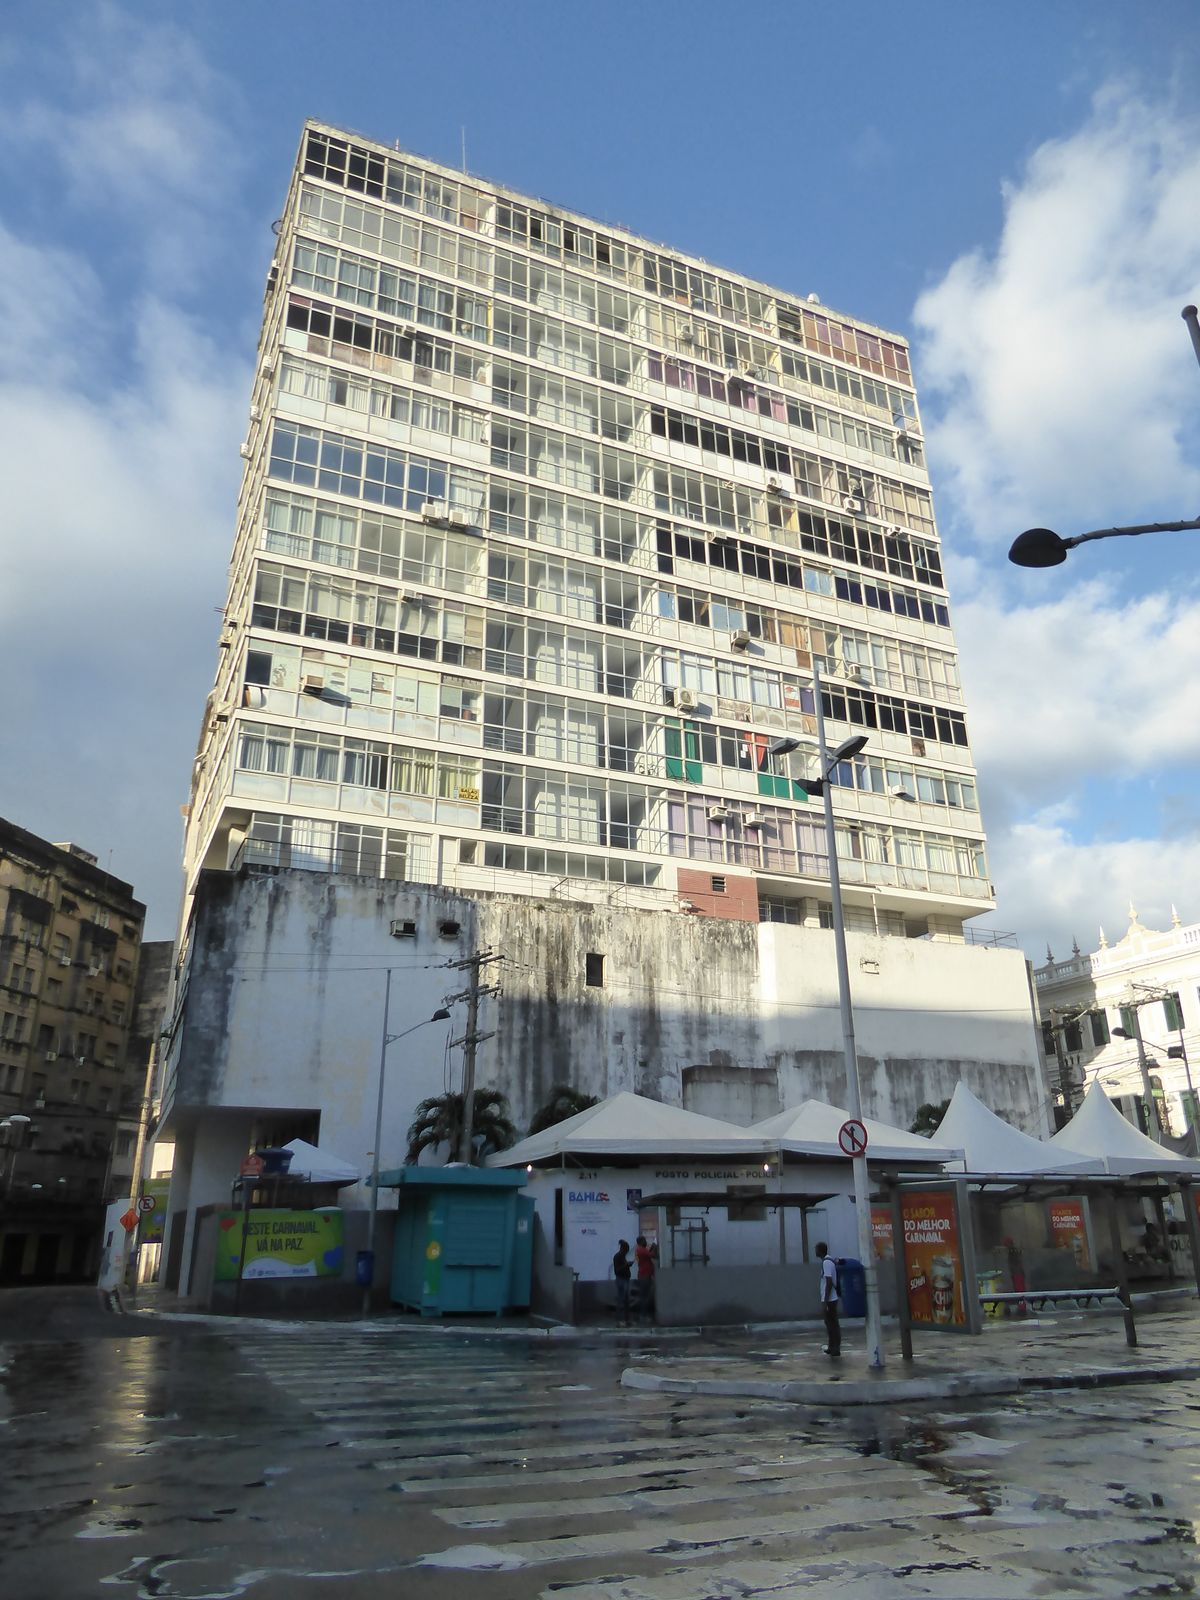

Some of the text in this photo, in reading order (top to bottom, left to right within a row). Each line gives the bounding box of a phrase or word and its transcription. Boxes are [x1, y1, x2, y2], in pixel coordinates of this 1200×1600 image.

[569, 1191, 609, 1202] BAHIA
[904, 1219, 950, 1230] DO MELHOR
[271, 1238, 282, 1251] NA
